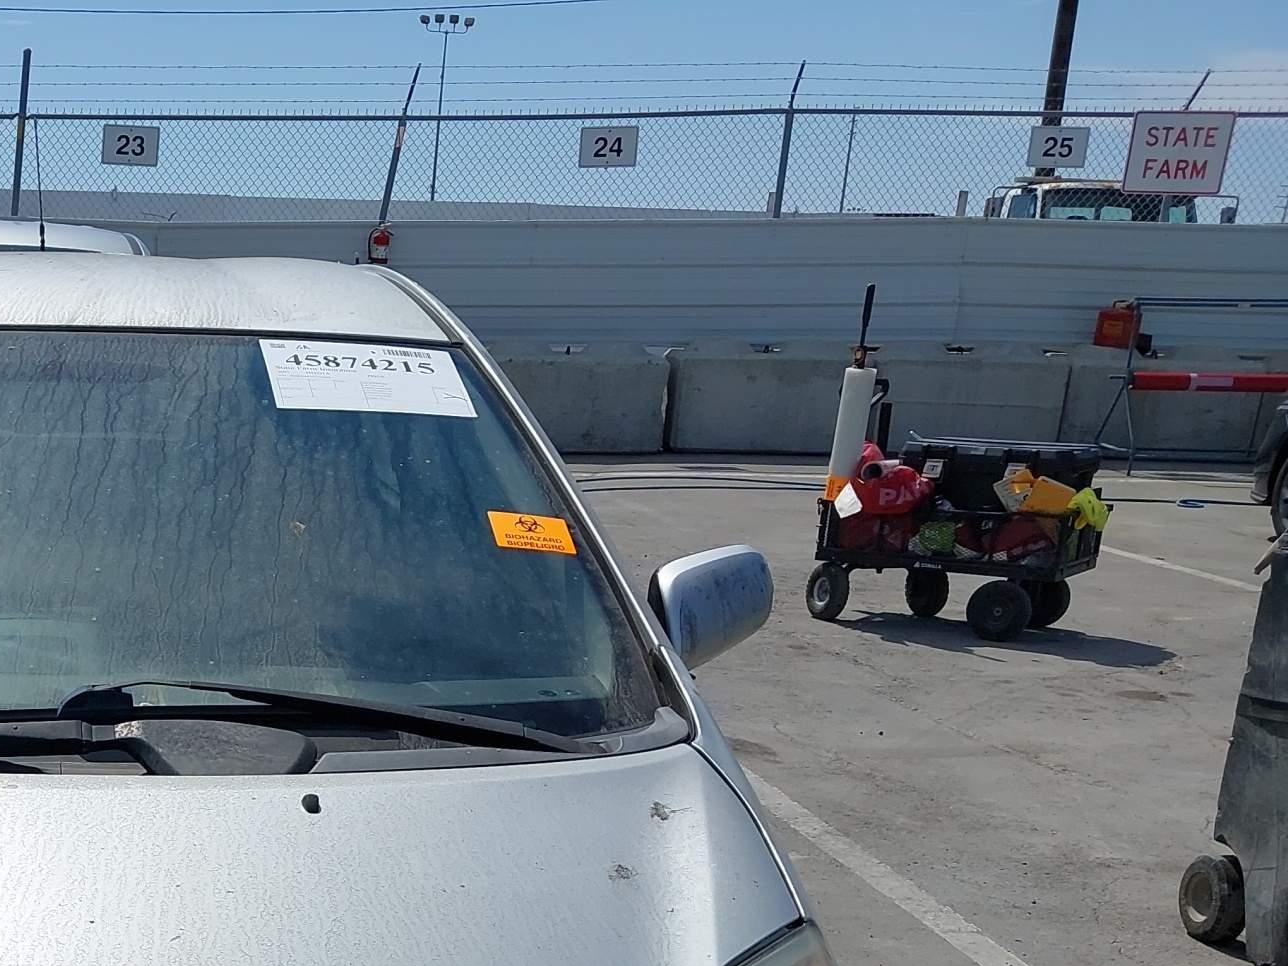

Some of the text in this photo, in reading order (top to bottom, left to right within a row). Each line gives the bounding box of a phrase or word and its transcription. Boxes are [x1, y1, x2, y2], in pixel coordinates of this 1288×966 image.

[116, 135, 145, 156] 23
[593, 137, 623, 157] 24
[1042, 136, 1074, 158] 25
[1145, 126, 1219, 148] STATE
[1142, 159, 1209, 180] FARM
[286, 354, 435, 375] 45874215
[504, 533, 563, 544] BIOHAZARD
[506, 540, 566, 551] BIOPELIGRO
